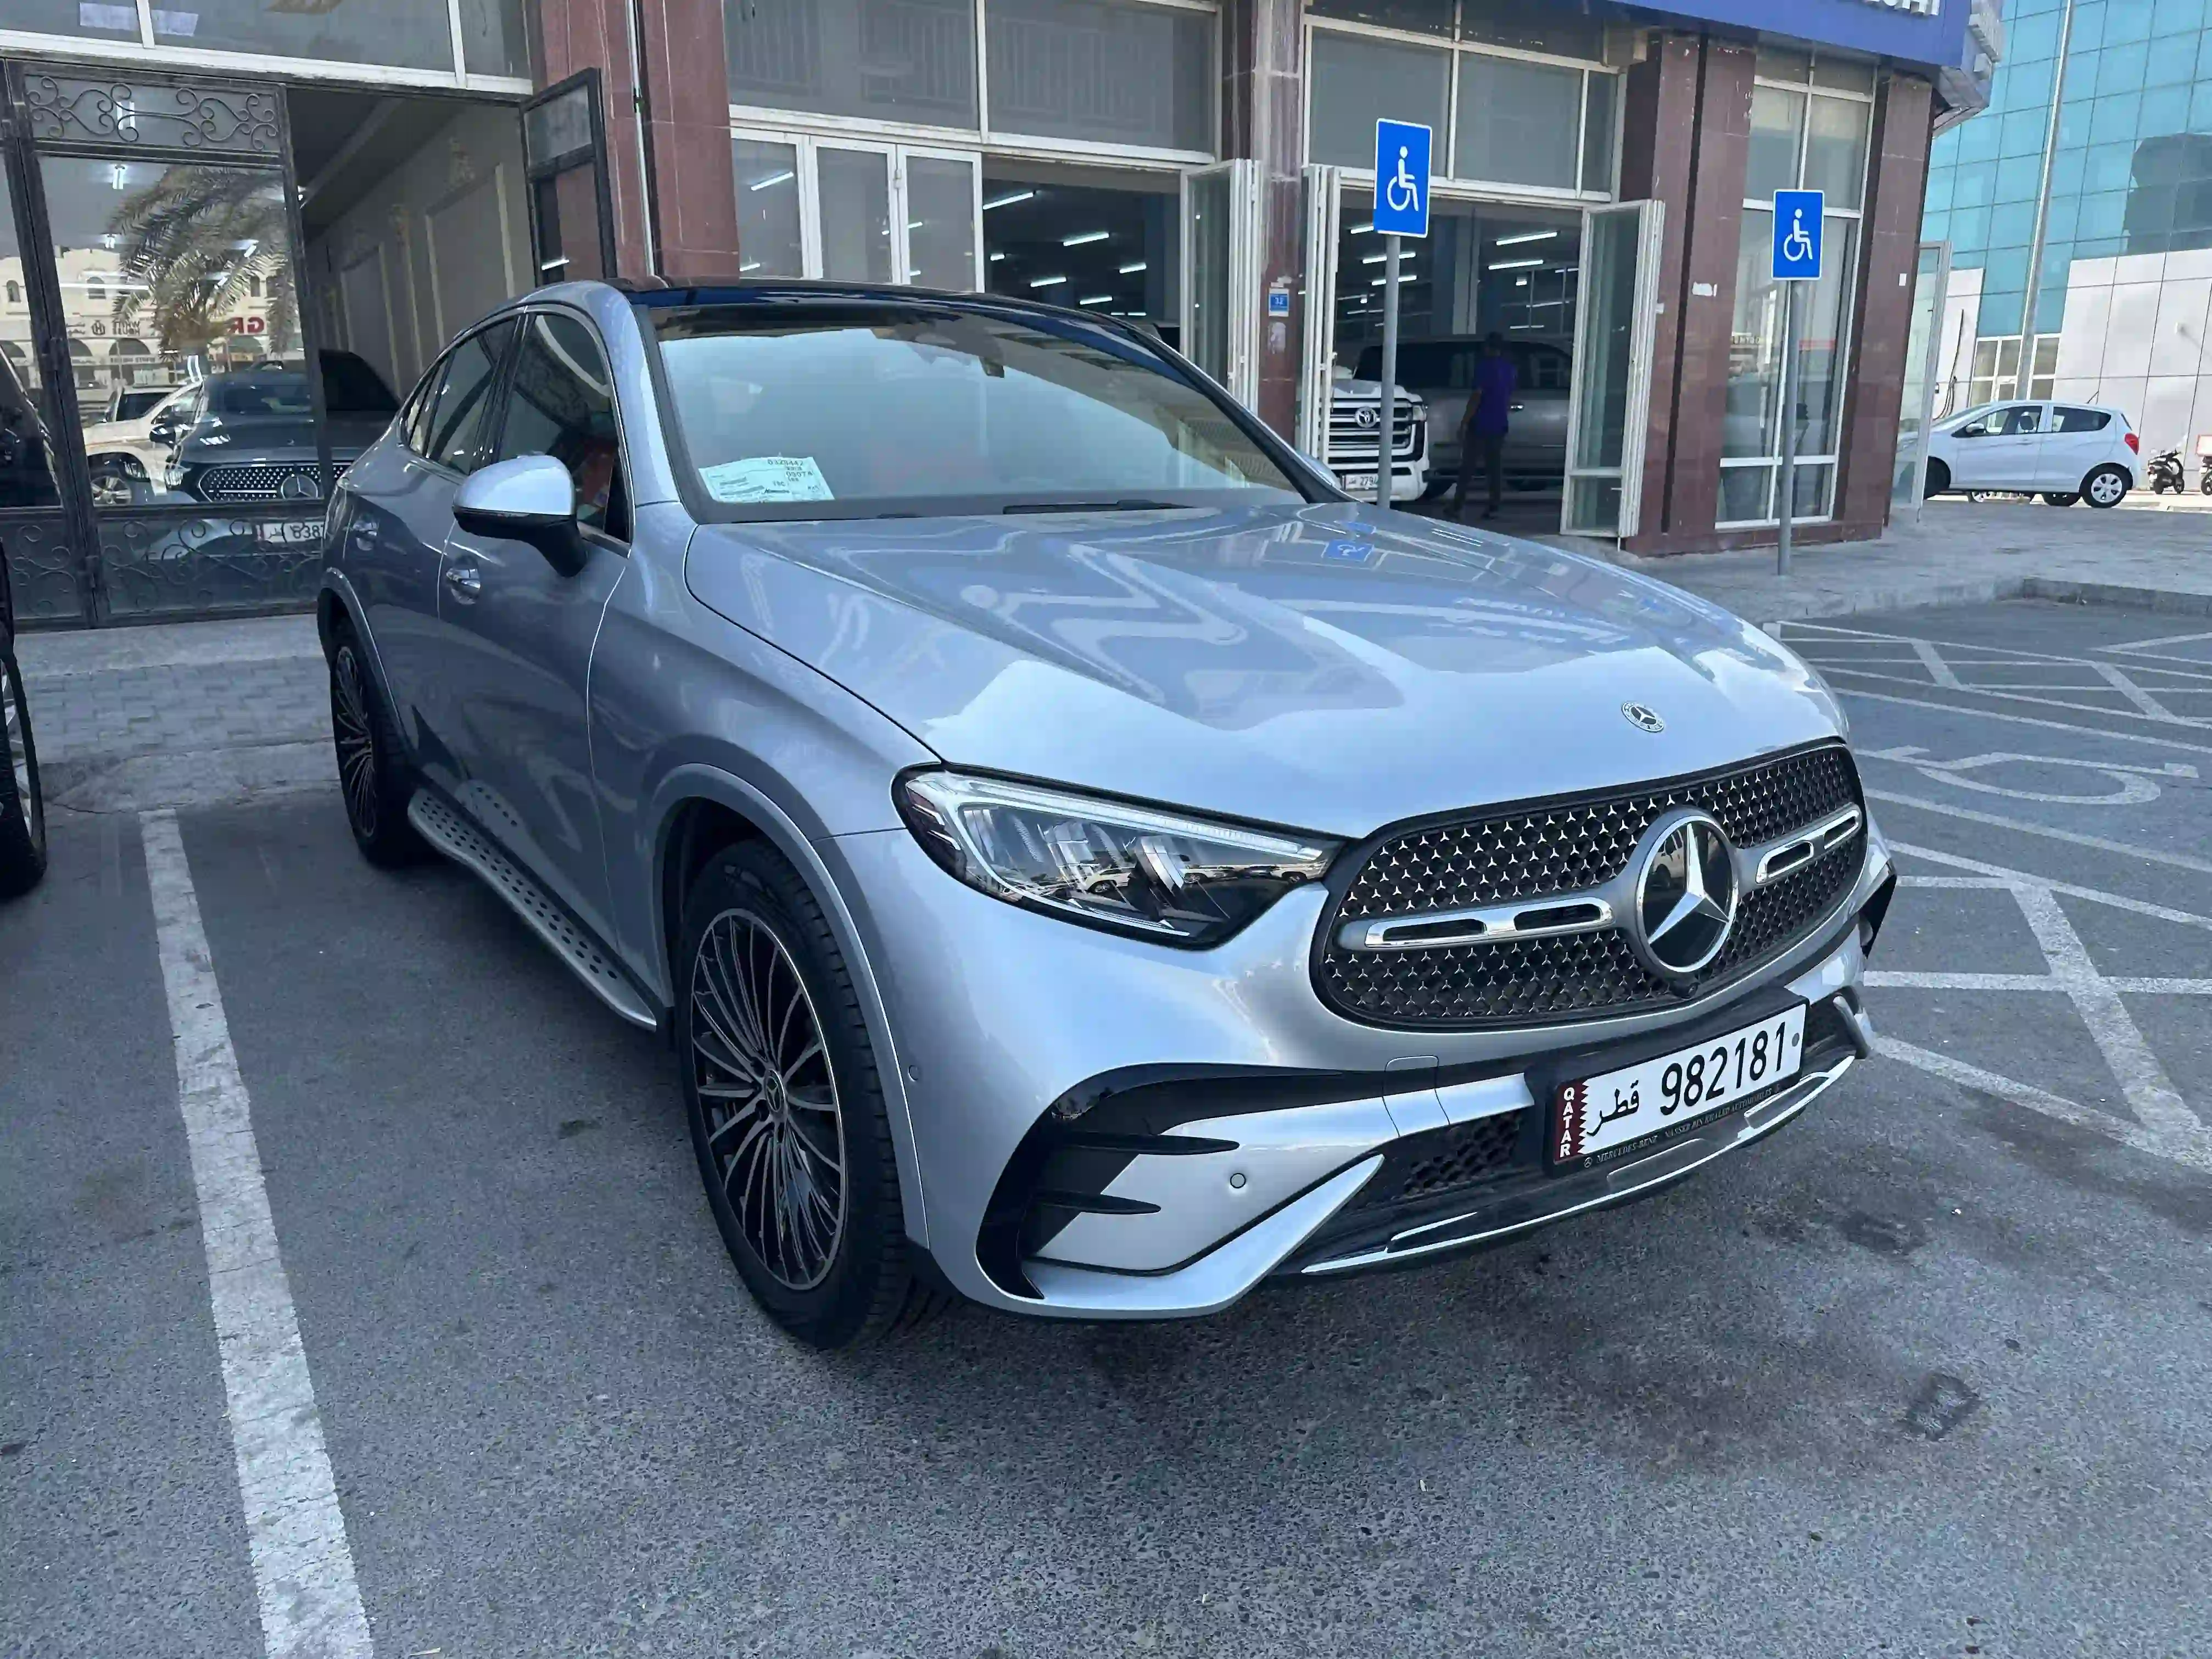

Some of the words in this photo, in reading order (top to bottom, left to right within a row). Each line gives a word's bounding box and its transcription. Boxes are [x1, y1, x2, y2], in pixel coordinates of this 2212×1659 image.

[1660, 1021, 1786, 1116] 982181
[1559, 1087, 1575, 1158] QATAR
[1587, 1080, 1639, 1136] قطر
[1597, 1135, 1658, 1163] MERCEDES-BENZ
